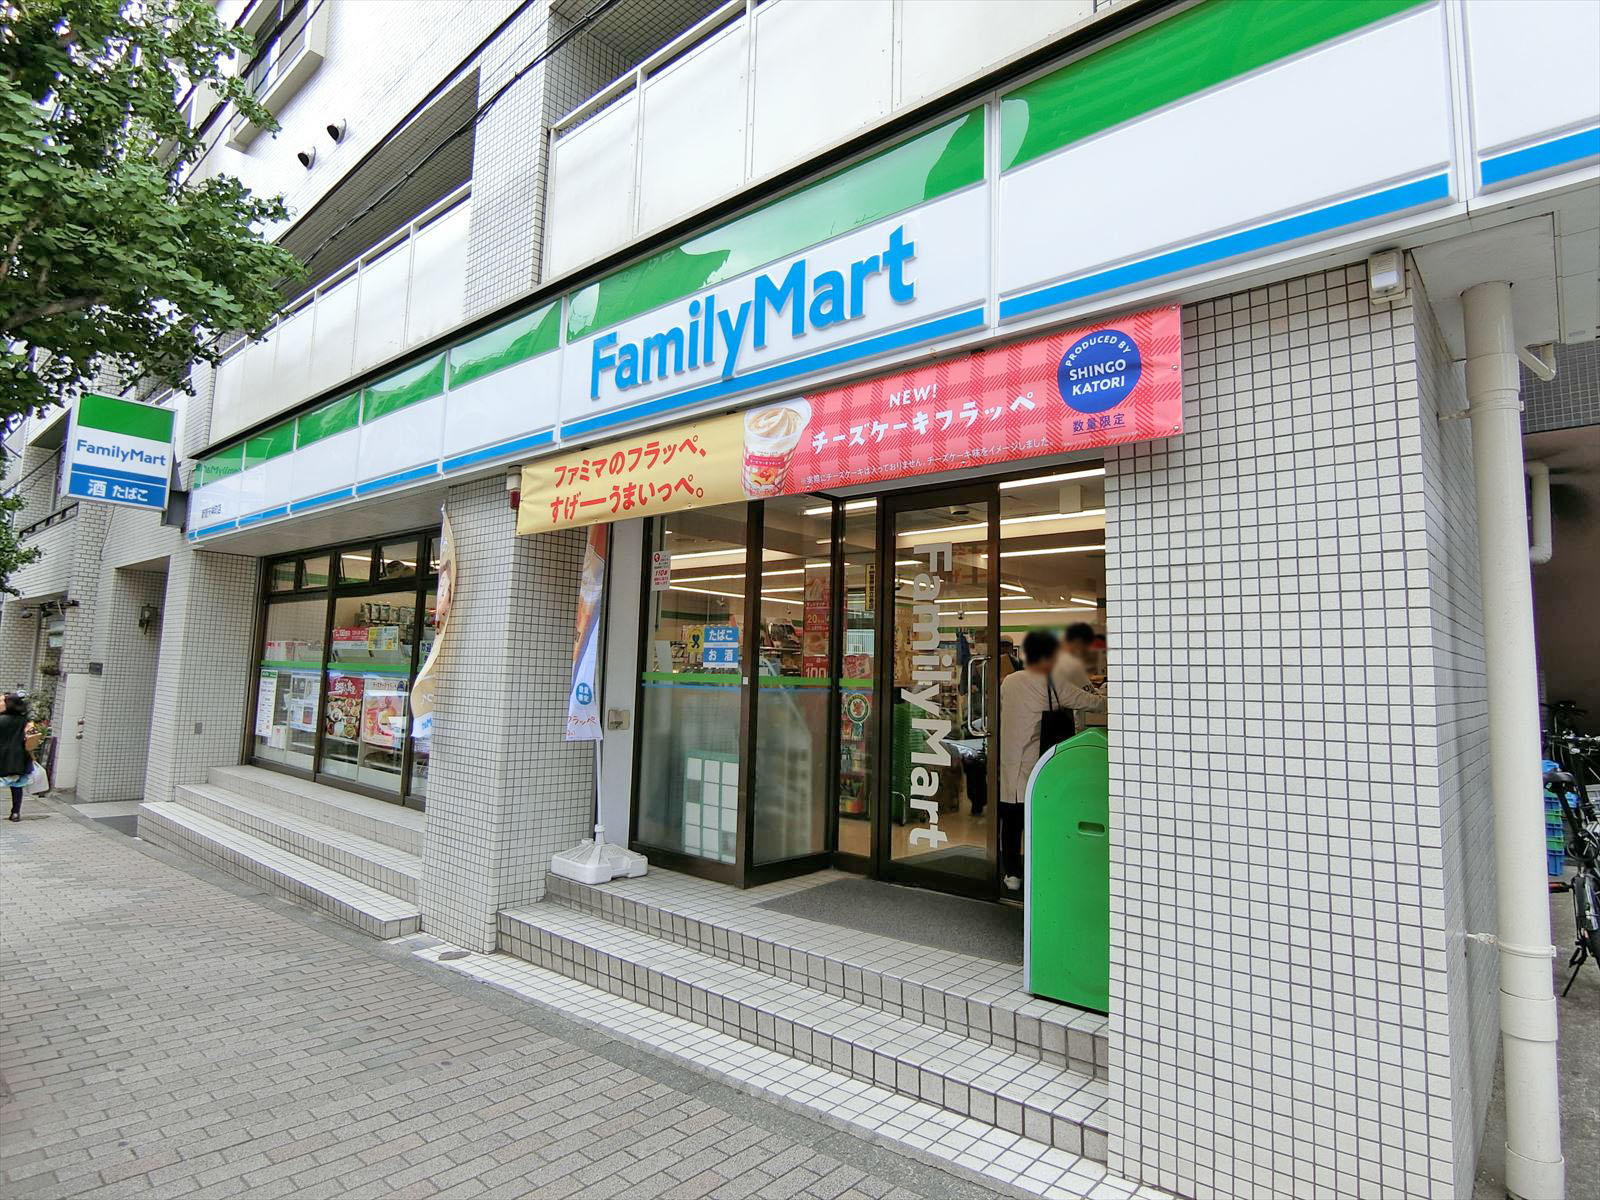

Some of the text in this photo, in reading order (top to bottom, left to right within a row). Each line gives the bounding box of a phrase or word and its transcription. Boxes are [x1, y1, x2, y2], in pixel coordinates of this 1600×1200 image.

[590, 224, 917, 400] FamilyMart
[1065, 335, 1131, 367] PRODUCED BY
[1069, 359, 1126, 380] SHINGO
[889, 384, 938, 408] NEW!
[1072, 376, 1125, 396] KATORI
[812, 391, 1036, 454] チーズケーキフラッペ
[1073, 413, 1125, 432] 数量限定
[76, 438, 166, 466] FamilyMart
[554, 434, 707, 488] ファミマのフラッペ、
[87, 479, 148, 502] 酒 たばこ
[709, 629, 734, 641] たばこ
[900, 541, 953, 850] FamilyMart
